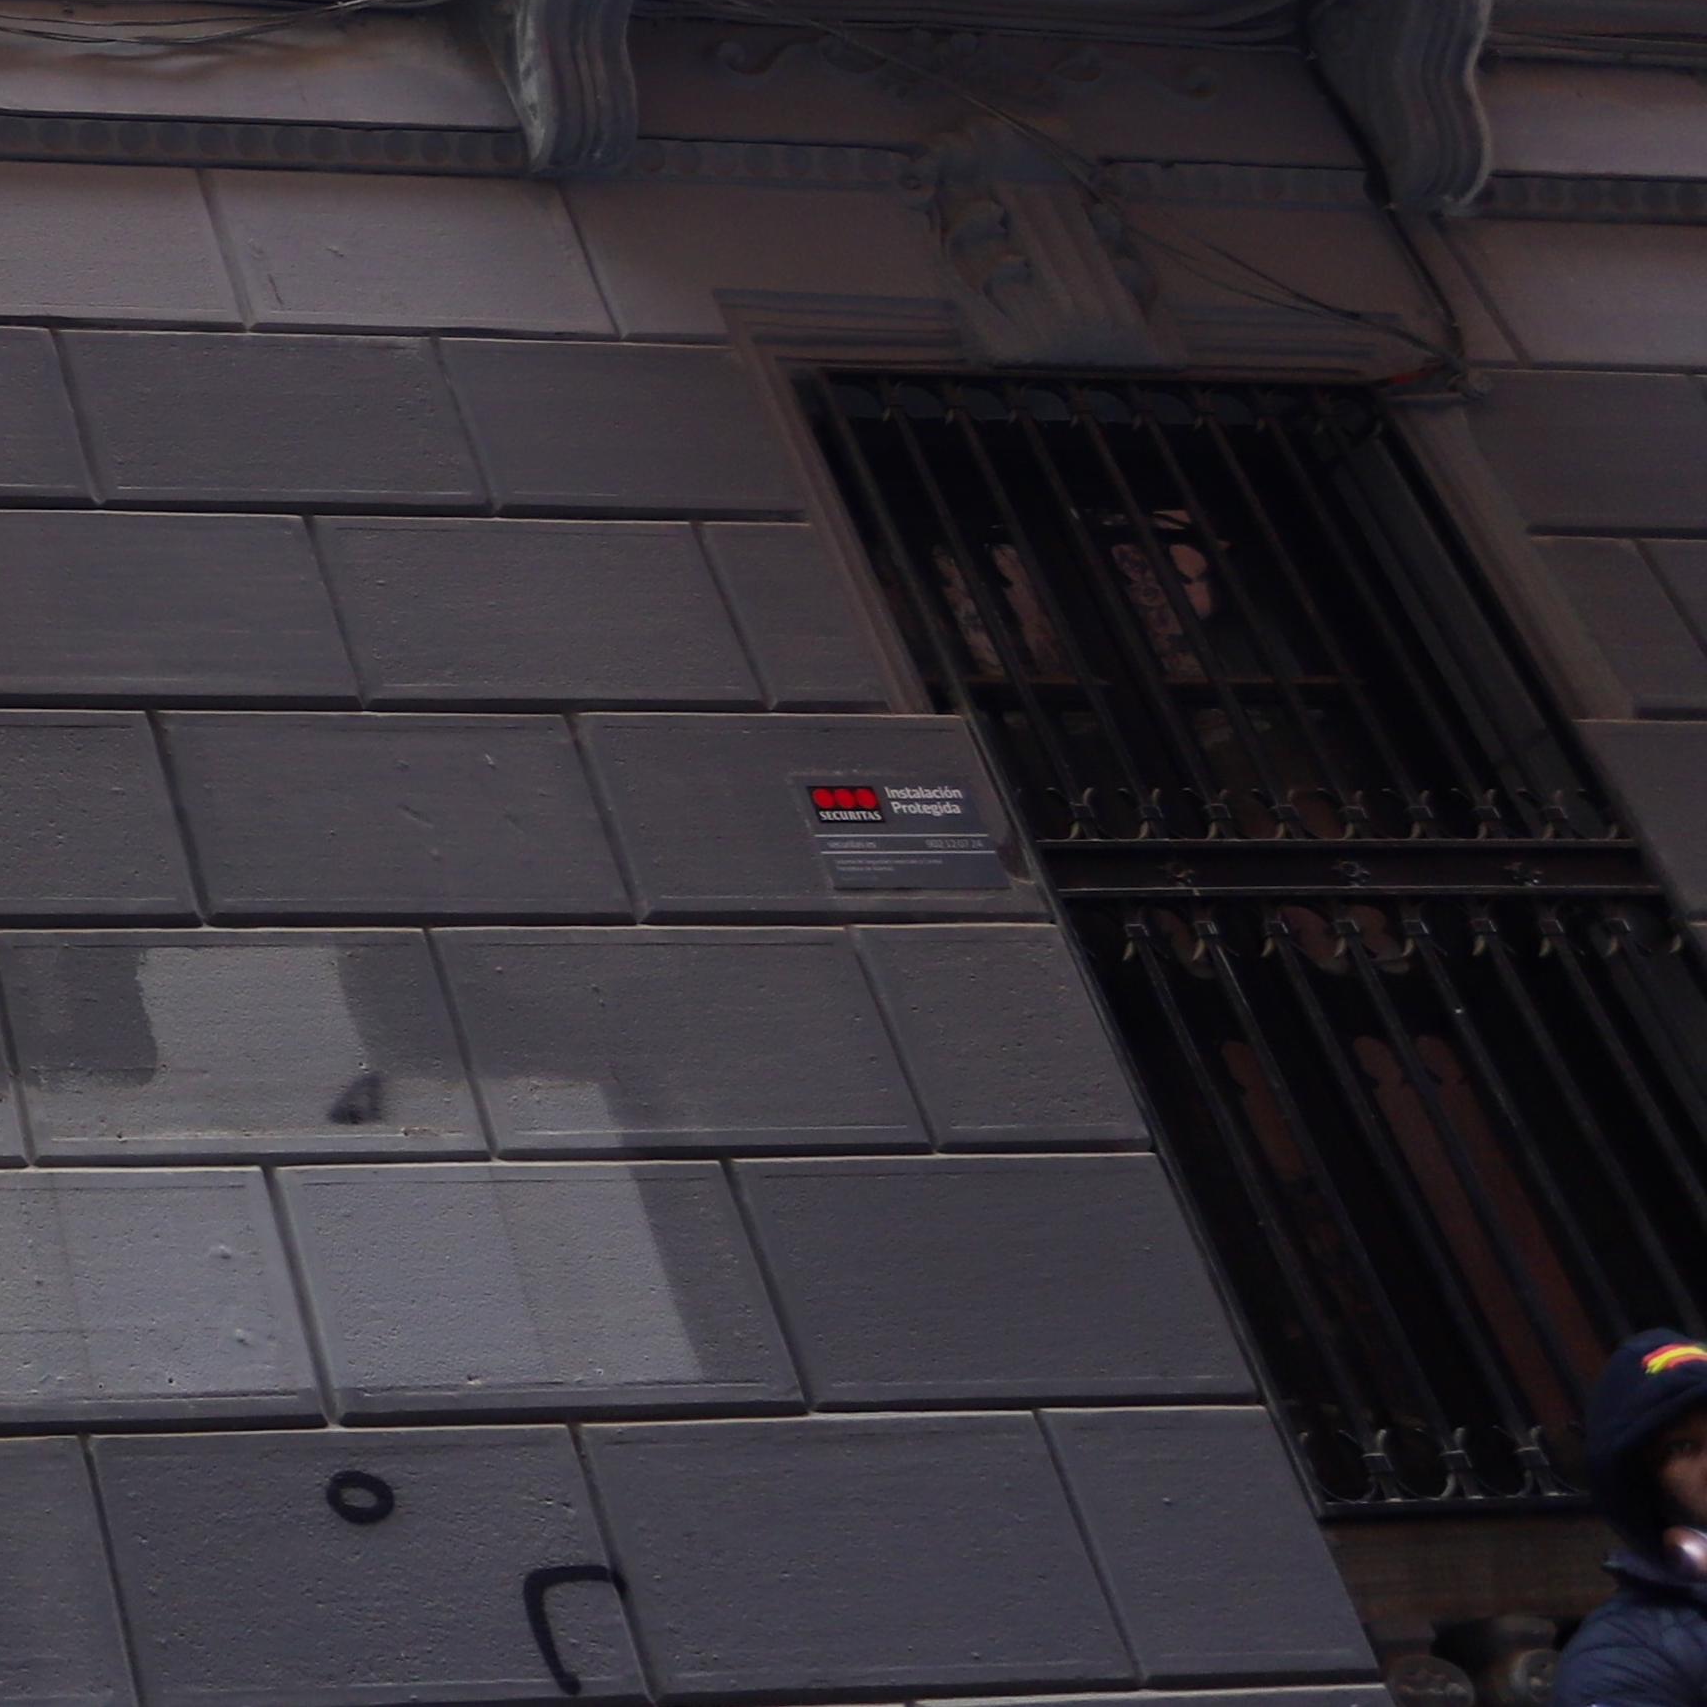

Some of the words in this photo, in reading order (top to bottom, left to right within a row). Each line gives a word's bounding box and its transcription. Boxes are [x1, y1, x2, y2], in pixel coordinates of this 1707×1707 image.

[886, 786, 963, 799] Instalación
[819, 810, 882, 821] SECURITAS
[891, 801, 962, 817] Protegida
